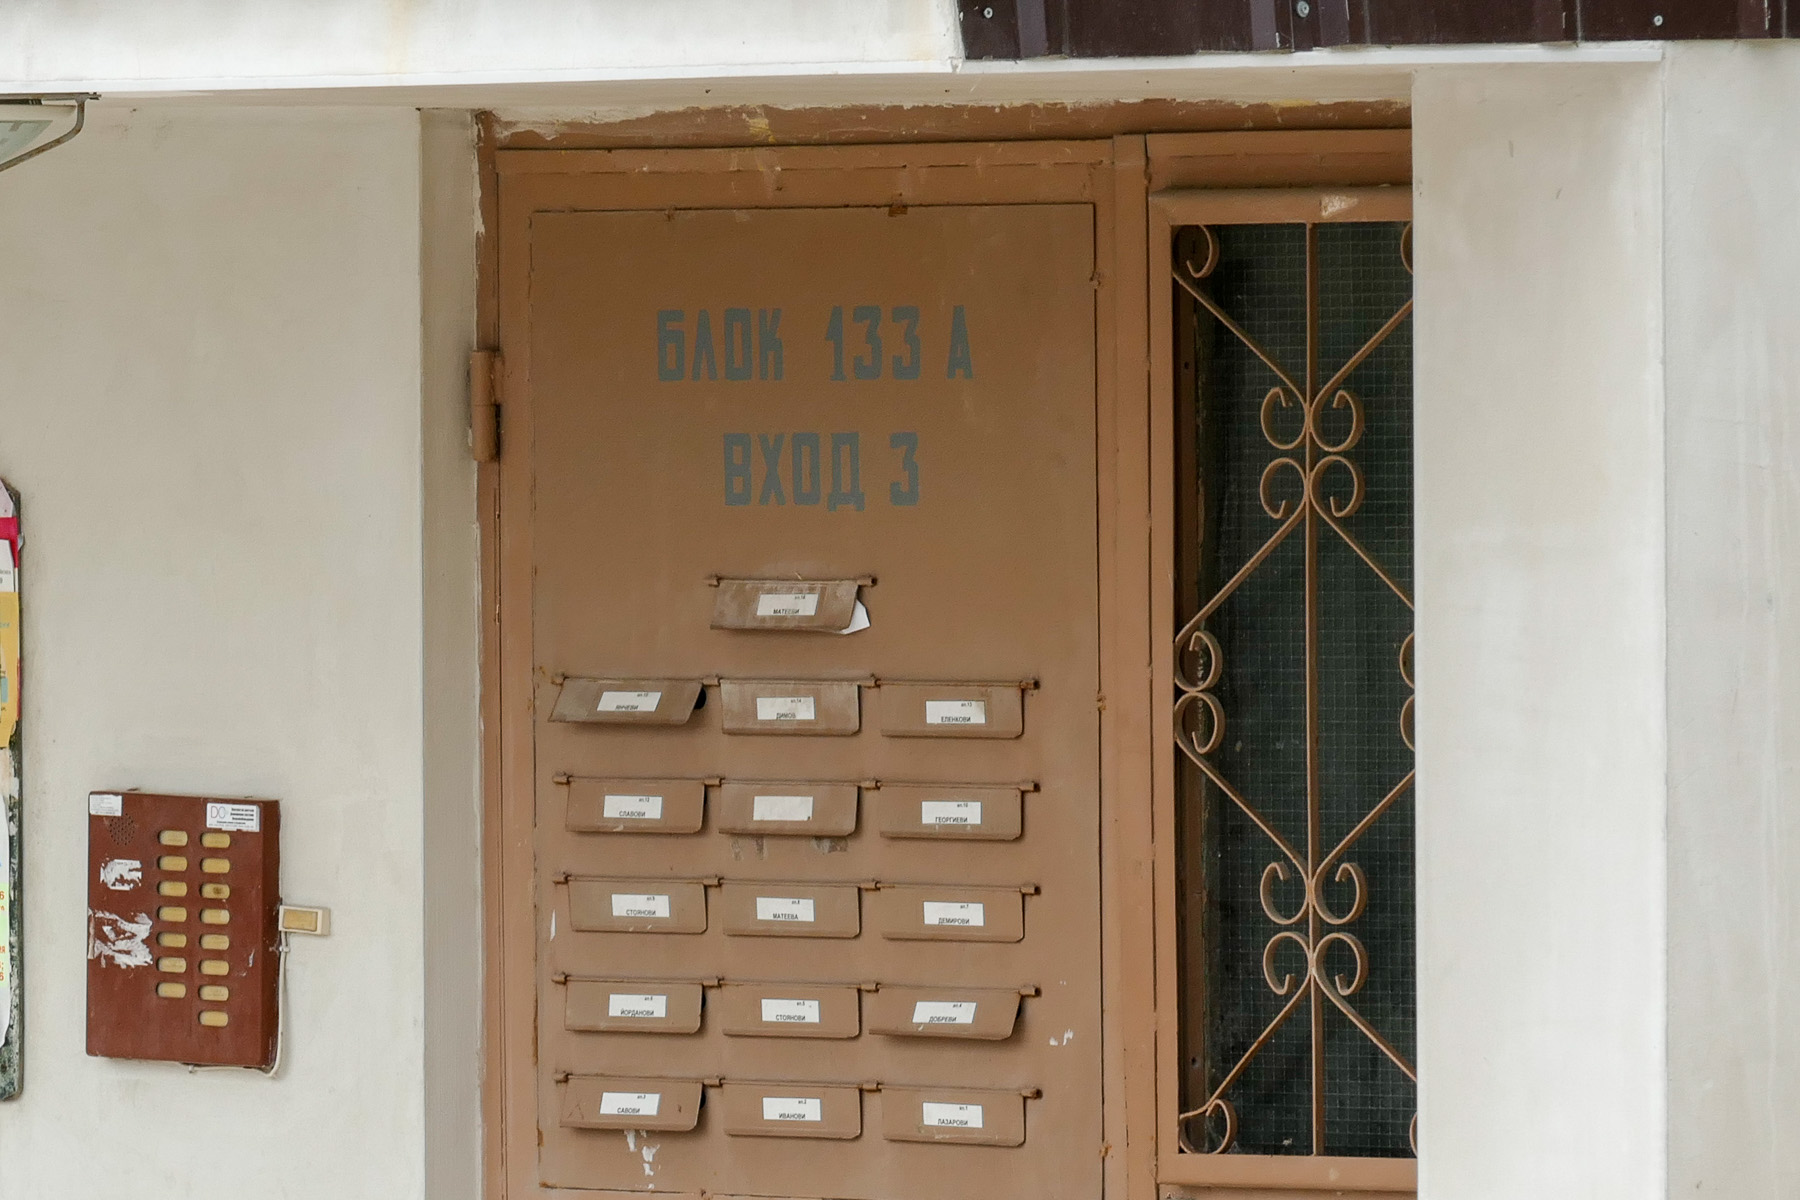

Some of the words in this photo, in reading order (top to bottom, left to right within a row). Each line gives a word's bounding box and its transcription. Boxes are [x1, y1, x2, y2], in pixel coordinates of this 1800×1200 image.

[656, 308, 785, 382] БЛОК
[825, 305, 921, 381] 133
[946, 305, 974, 379] А
[723, 431, 866, 512] ВХОД
[889, 431, 920, 506] 3
[776, 712, 797, 720] ДИМОВ
[935, 816, 968, 824] ГЕОРГИЕВИ
[938, 917, 971, 925] ДЕМИРОВИ
[620, 1009, 655, 1017] ЙОРДАНОВИ
[775, 1014, 806, 1022] СТОЯНОВИ
[938, 1118, 969, 1126] ЛАЗАРОВИ
